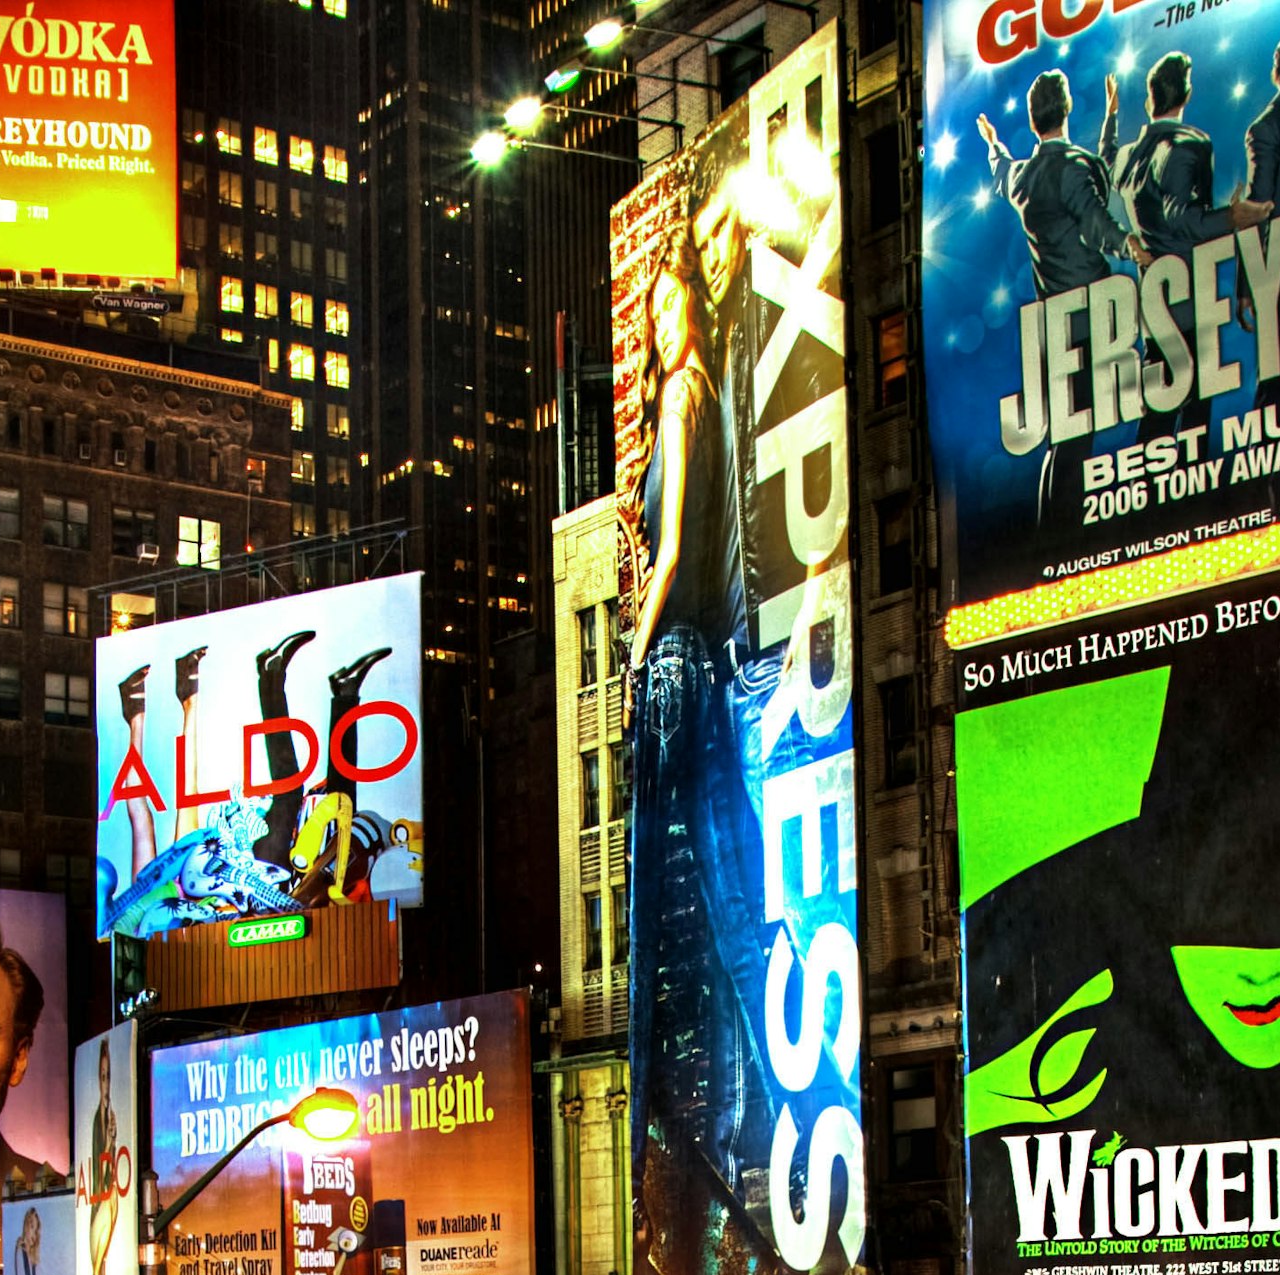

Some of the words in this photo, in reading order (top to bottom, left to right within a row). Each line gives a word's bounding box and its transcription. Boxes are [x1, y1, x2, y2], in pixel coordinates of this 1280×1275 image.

[0, 149, 53, 168] Vodka.
[57, 152, 105, 171] Priced
[109, 155, 155, 176] Right.
[99, 296, 120, 307] Van
[123, 297, 166, 312] Wagner
[1083, 425, 1208, 492] BEST
[1083, 480, 1148, 525] 2006
[1153, 458, 1225, 504] TONY
[1056, 549, 1122, 577] AUGUST
[1125, 530, 1191, 559] WILSON
[1194, 509, 1277, 543] THEATRE,
[748, 17, 866, 1271] EXPRESS
[100, 700, 419, 821] ALDO
[234, 920, 302, 944] LAMAR
[186, 1059, 229, 1104] Why
[234, 1053, 269, 1095] the
[275, 1047, 312, 1089] city
[320, 1037, 384, 1082] never
[390, 1016, 479, 1073] sleeps?
[367, 1083, 402, 1136] all
[410, 1071, 495, 1134] night.
[76, 1146, 132, 1208] ALDO
[293, 1200, 332, 1228] Bedbug
[417, 1219, 437, 1236] Now
[440, 1214, 484, 1236] Available
[174, 1236, 204, 1257] Early
[205, 1231, 258, 1253] Detection
[260, 1228, 277, 1251] Kit
[293, 1226, 315, 1248] Early
[294, 1248, 335, 1269] Detection
[1166, 1263, 1186, 1275] 222
[1188, 1261, 1219, 1275] WEST
